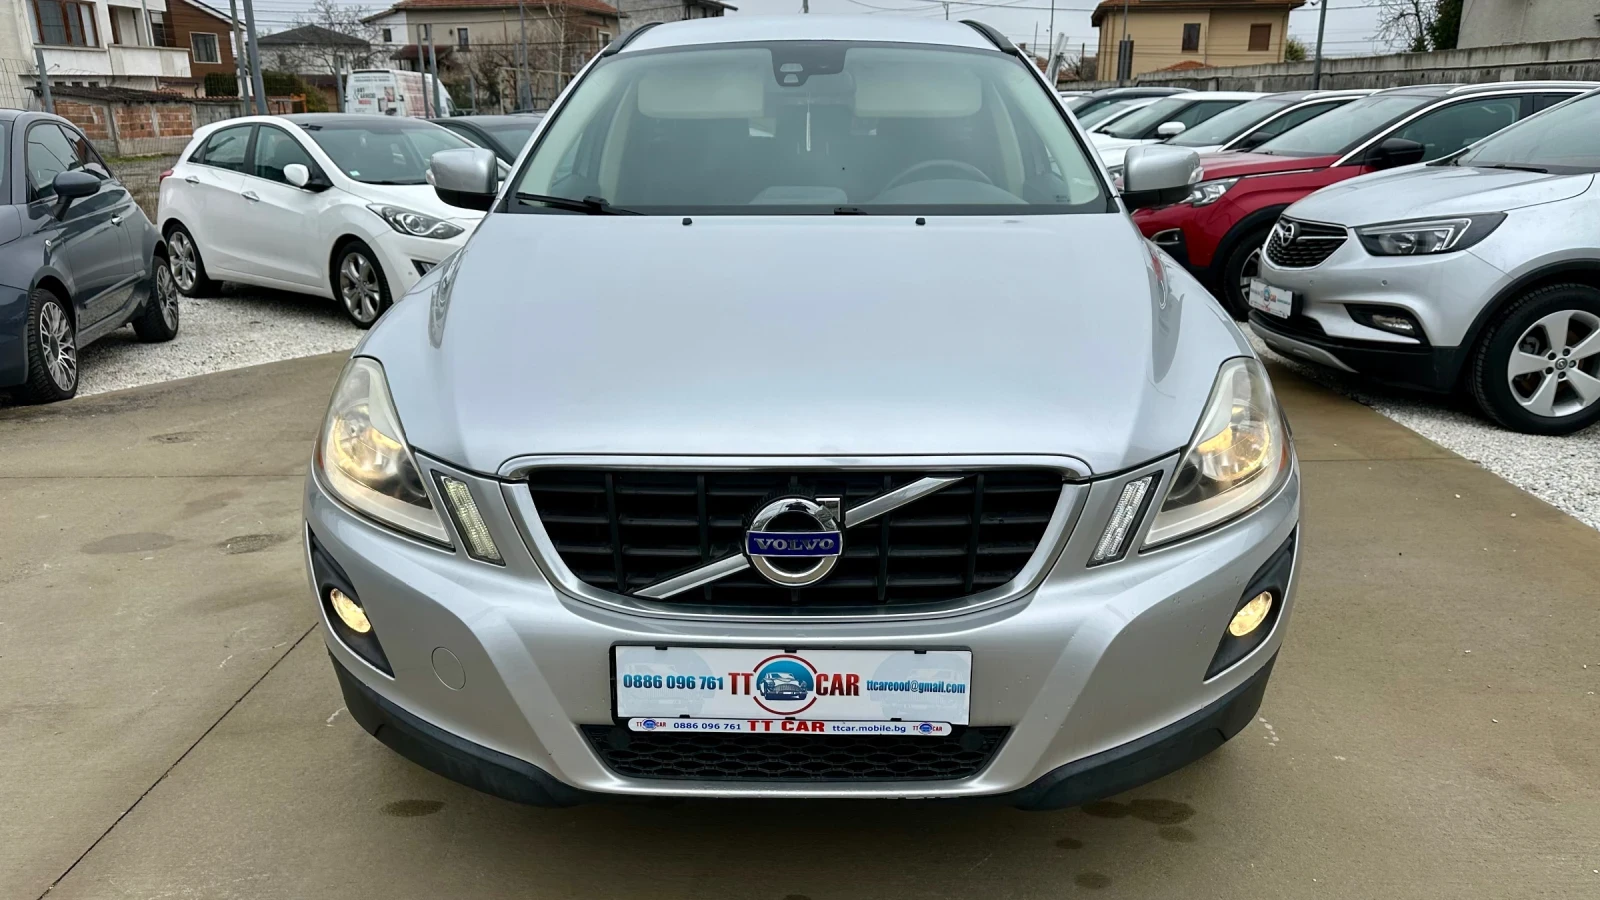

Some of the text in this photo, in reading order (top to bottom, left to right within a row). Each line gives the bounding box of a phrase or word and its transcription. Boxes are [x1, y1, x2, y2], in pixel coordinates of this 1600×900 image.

[754, 538, 835, 551] VOLVO
[623, 674, 724, 690] 0886 096 761
[728, 672, 860, 697] TT CAR
[866, 680, 966, 694] ttcareood@gmail.com
[747, 720, 825, 732] TT CAR
[832, 724, 906, 734] ttcar.mobile.bg
